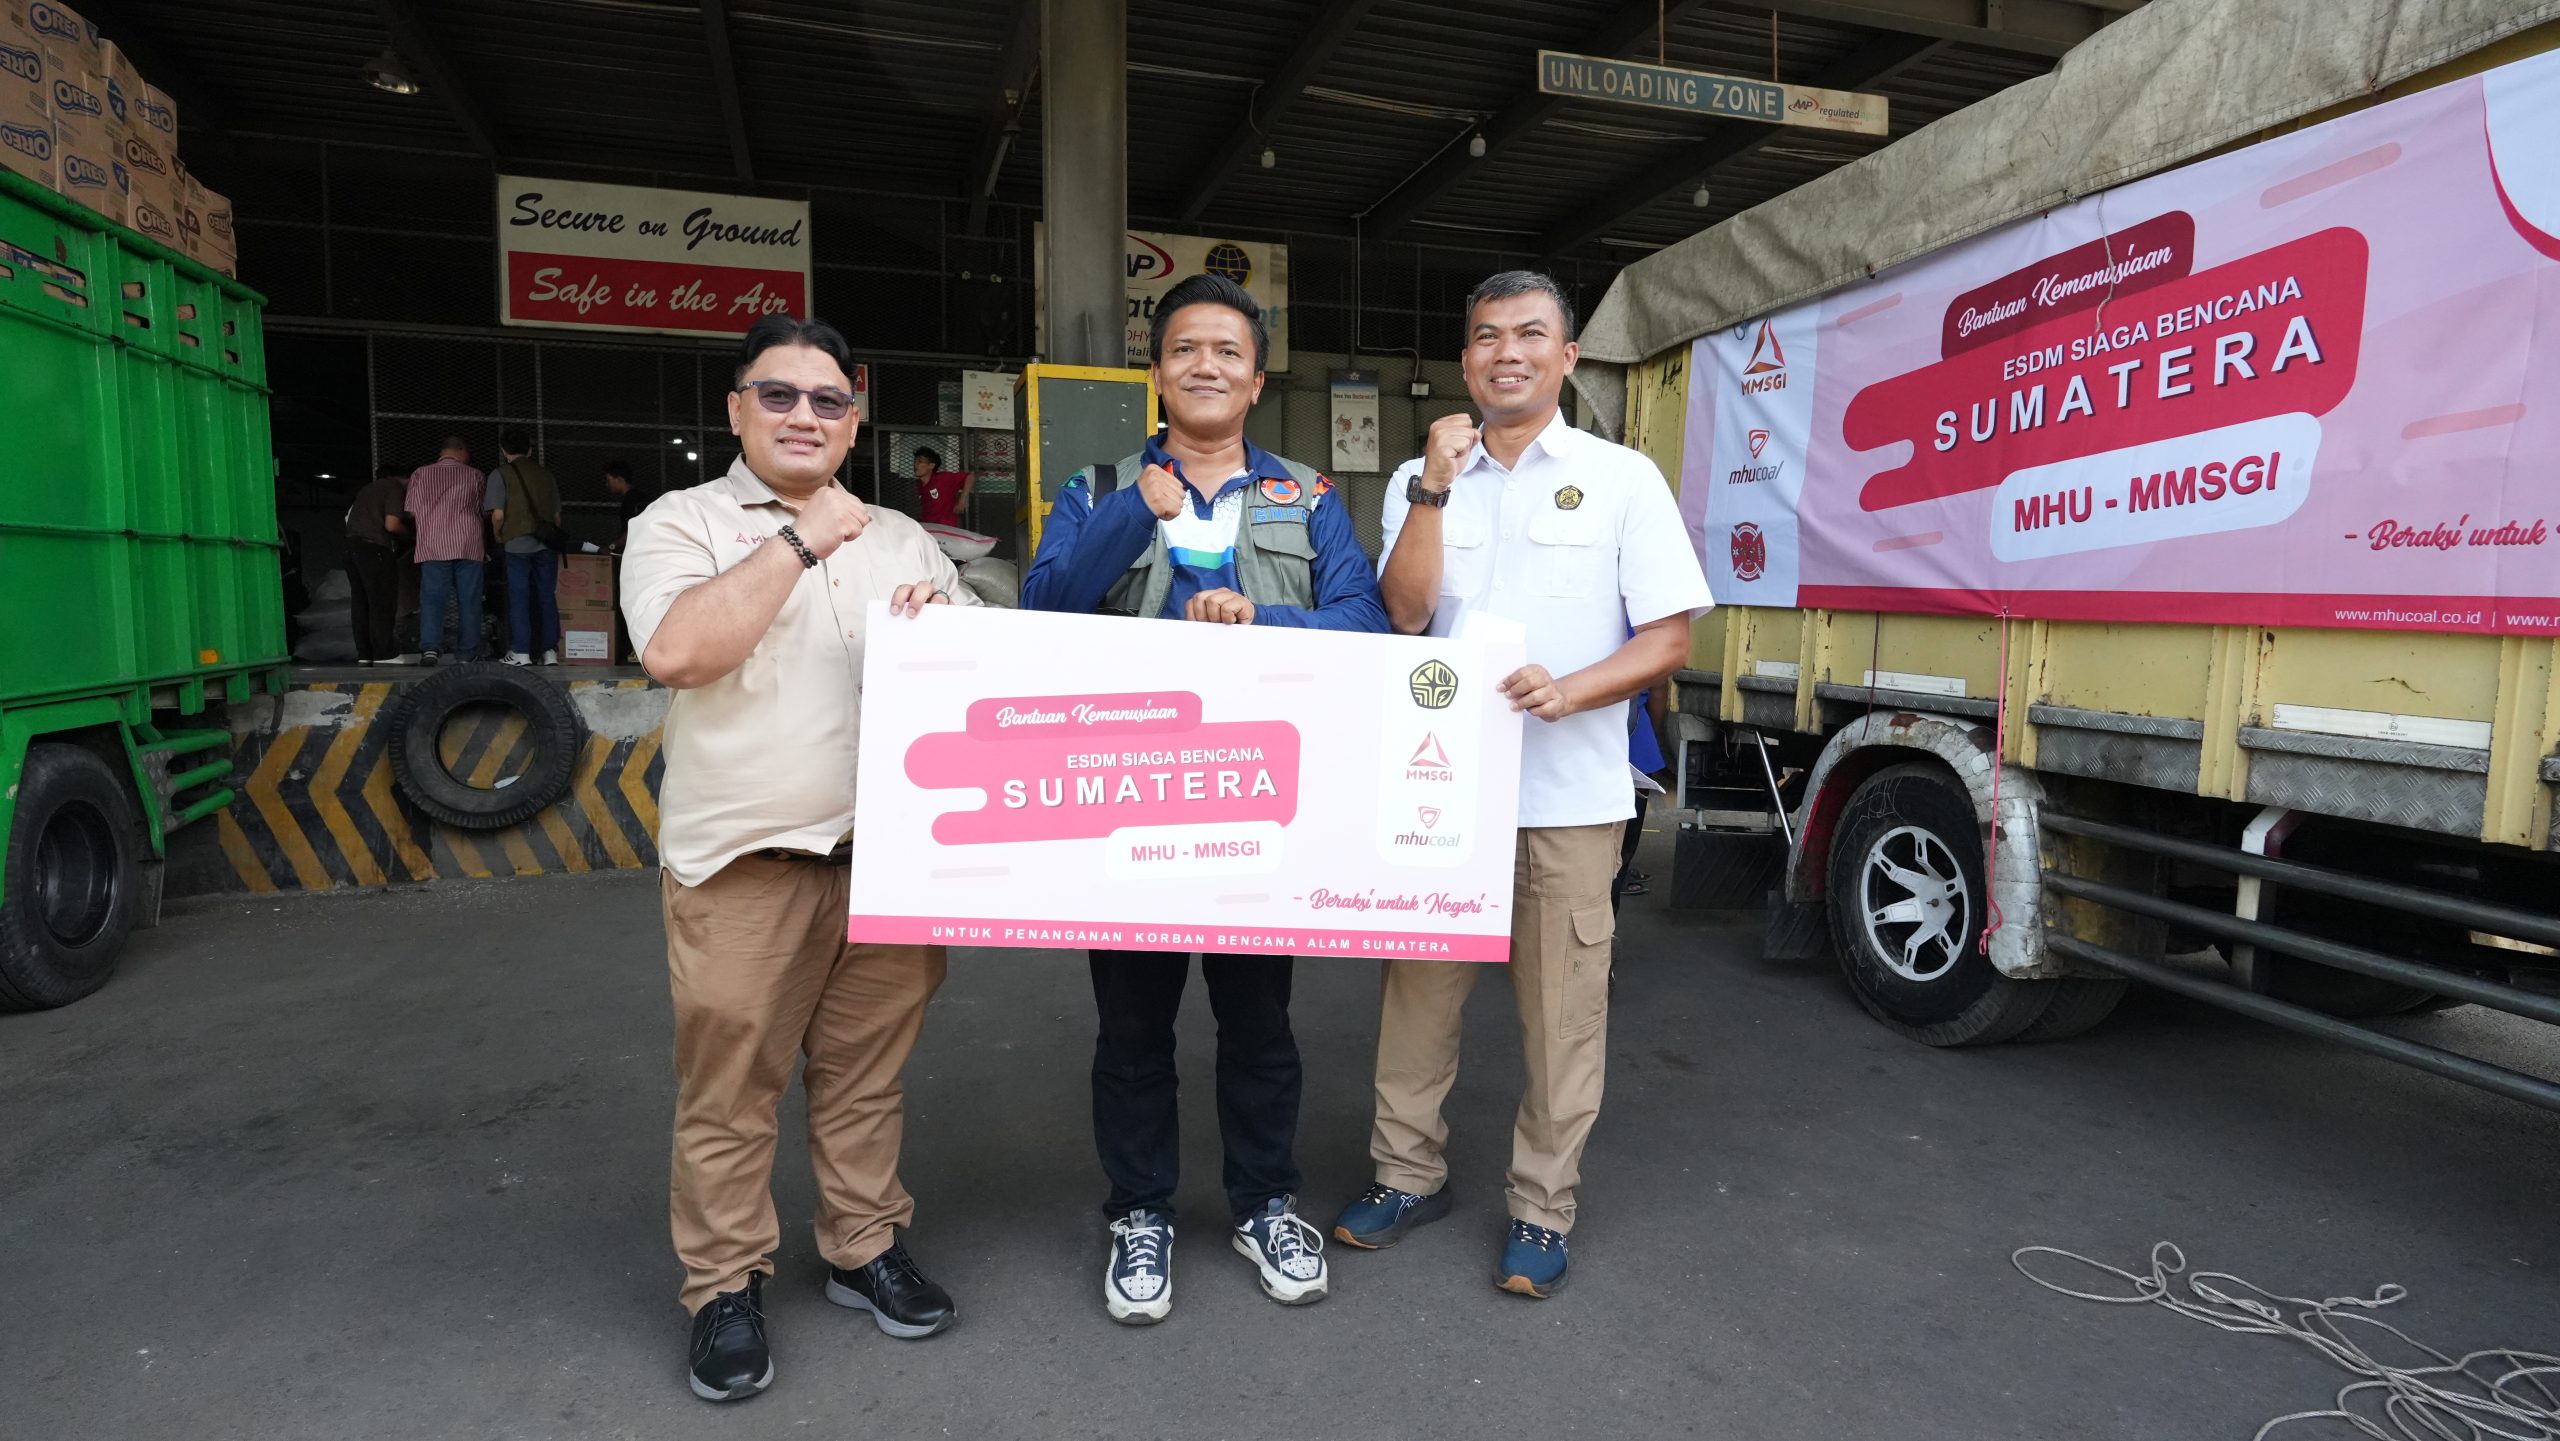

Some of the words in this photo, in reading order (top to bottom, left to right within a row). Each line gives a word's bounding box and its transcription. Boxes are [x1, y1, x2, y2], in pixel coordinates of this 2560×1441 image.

[54, 80, 102, 116] OREO
[1551, 61, 1697, 105] UNLOADING
[1712, 83, 1777, 115] ZONE
[1820, 107, 1860, 119] regulated
[1, 125, 51, 160] OREO
[126, 140, 166, 175] OREO
[64, 155, 107, 186] OREO
[136, 206, 174, 238] OREO
[510, 193, 625, 234] Secure
[638, 217, 668, 236] on
[683, 207, 802, 250] Ground
[528, 267, 612, 315] Safe
[624, 283, 658, 309] in
[669, 279, 718, 312] the
[728, 282, 790, 315] Air
[1958, 297, 2028, 338] Bantuan
[2031, 244, 2173, 307] Kemanusiaan
[2003, 343, 2064, 382] ESDM
[2070, 326, 2150, 362] SIAGA
[2156, 275, 2303, 340] BENCANA
[1740, 373, 1787, 397] MMSGI
[1933, 315, 2324, 454] SUMATERA
[1728, 460, 1784, 485] mhucoal
[2014, 486, 2092, 532] MHU
[2128, 451, 2281, 513] MMSGI
[2368, 513, 2470, 550] Beraksi
[2468, 518, 2548, 547] untuk
[2335, 608, 2481, 625] www.mhucoal.co.id
[996, 706, 1067, 728] Bantuan
[1072, 699, 1178, 726] Kemanusiaan
[1067, 753, 1117, 769] ESDM
[1121, 750, 1176, 767] SIAGA
[1180, 747, 1265, 765] BENCANA
[1003, 768, 1279, 810] SUMATERA
[1406, 769, 1453, 782] MMSGI
[1131, 845, 1175, 862] MHU
[1194, 841, 1261, 859] MMSGI
[1394, 832, 1461, 848] mhucoal
[1309, 888, 1376, 912] Beraksi
[1376, 894, 1419, 911] untuk
[1424, 892, 1486, 919] Negeri
[932, 926, 992, 939] UNTUK
[1005, 928, 1122, 943] PENANGANAN
[1135, 932, 1205, 945] KORBAN
[1217, 935, 1296, 948] BENCANA
[1307, 937, 1351, 949] ALAM
[1362, 939, 1450, 953] SUMATERA
